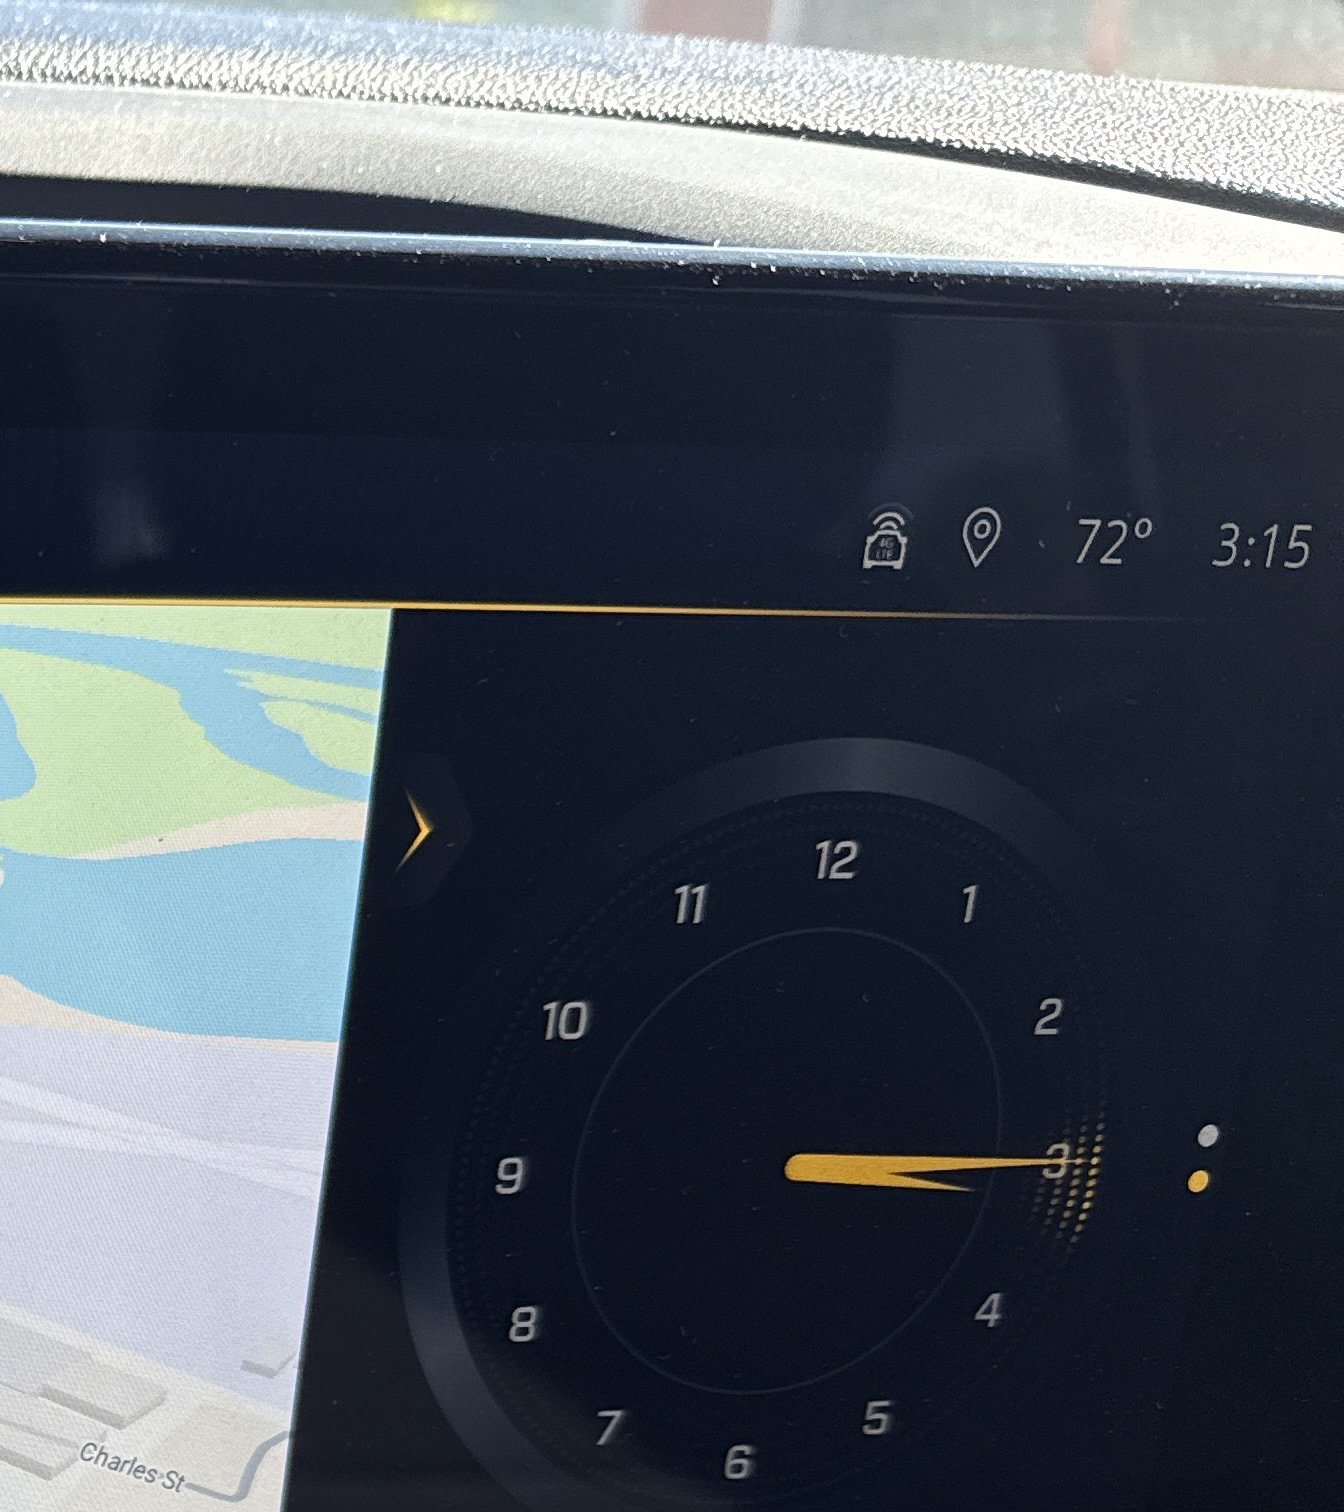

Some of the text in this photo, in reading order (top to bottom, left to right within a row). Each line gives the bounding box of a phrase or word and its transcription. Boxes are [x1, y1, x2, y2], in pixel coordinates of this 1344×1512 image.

[1077, 517, 1153, 565] 72°
[1212, 522, 1313, 569] 3:15
[814, 840, 858, 880] 12
[675, 884, 708, 924] 11
[962, 885, 978, 922] 1
[543, 1001, 589, 1040] 10
[1034, 998, 1062, 1036] 2
[494, 1157, 525, 1194] 9
[1045, 1142, 1070, 1180] 3
[508, 1306, 538, 1342] 8
[975, 1294, 1003, 1328] 4
[596, 1411, 625, 1444] 7
[863, 1402, 892, 1434] 5
[80, 1441, 186, 1493] Charles St
[724, 1445, 754, 1479] 6
